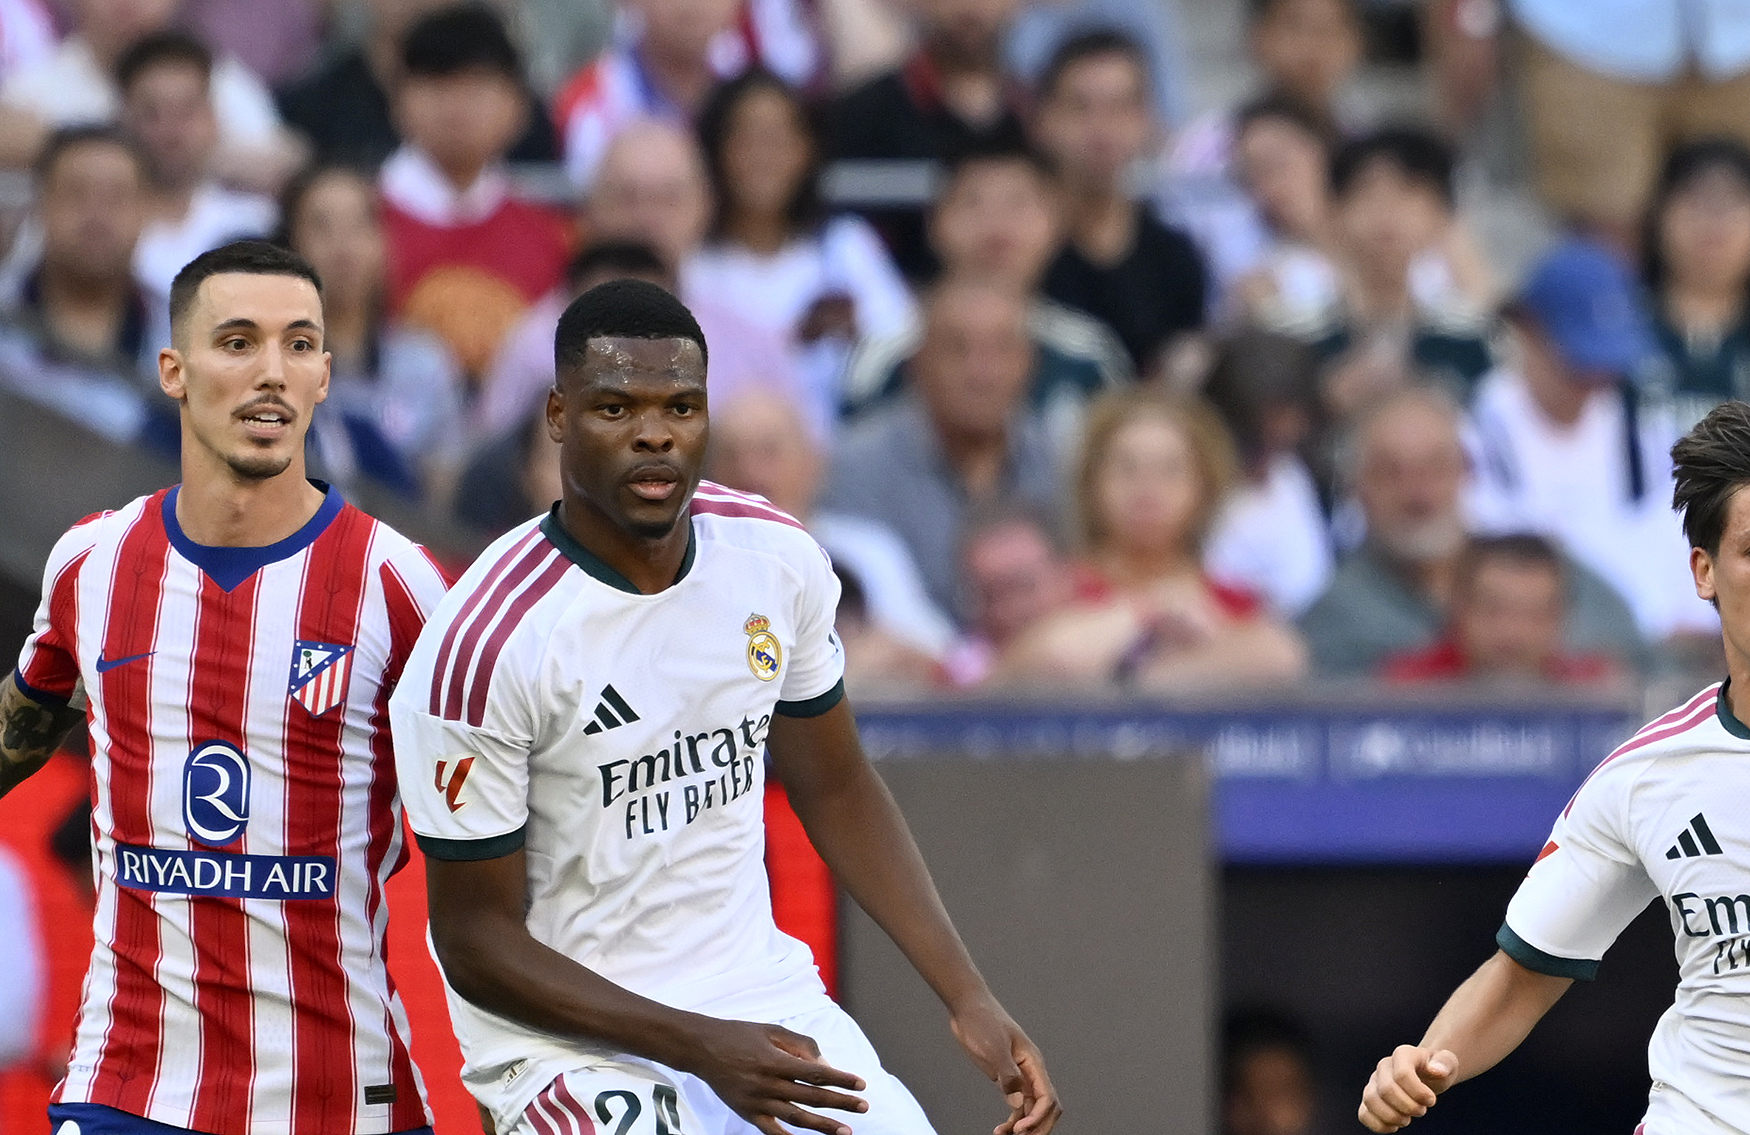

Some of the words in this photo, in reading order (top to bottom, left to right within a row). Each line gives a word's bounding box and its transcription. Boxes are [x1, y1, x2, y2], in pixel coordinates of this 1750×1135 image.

[597, 714, 769, 808] Emirate
[626, 791, 669, 839] FLY
[122, 850, 251, 892] RIYADH
[262, 862, 328, 893] AIR
